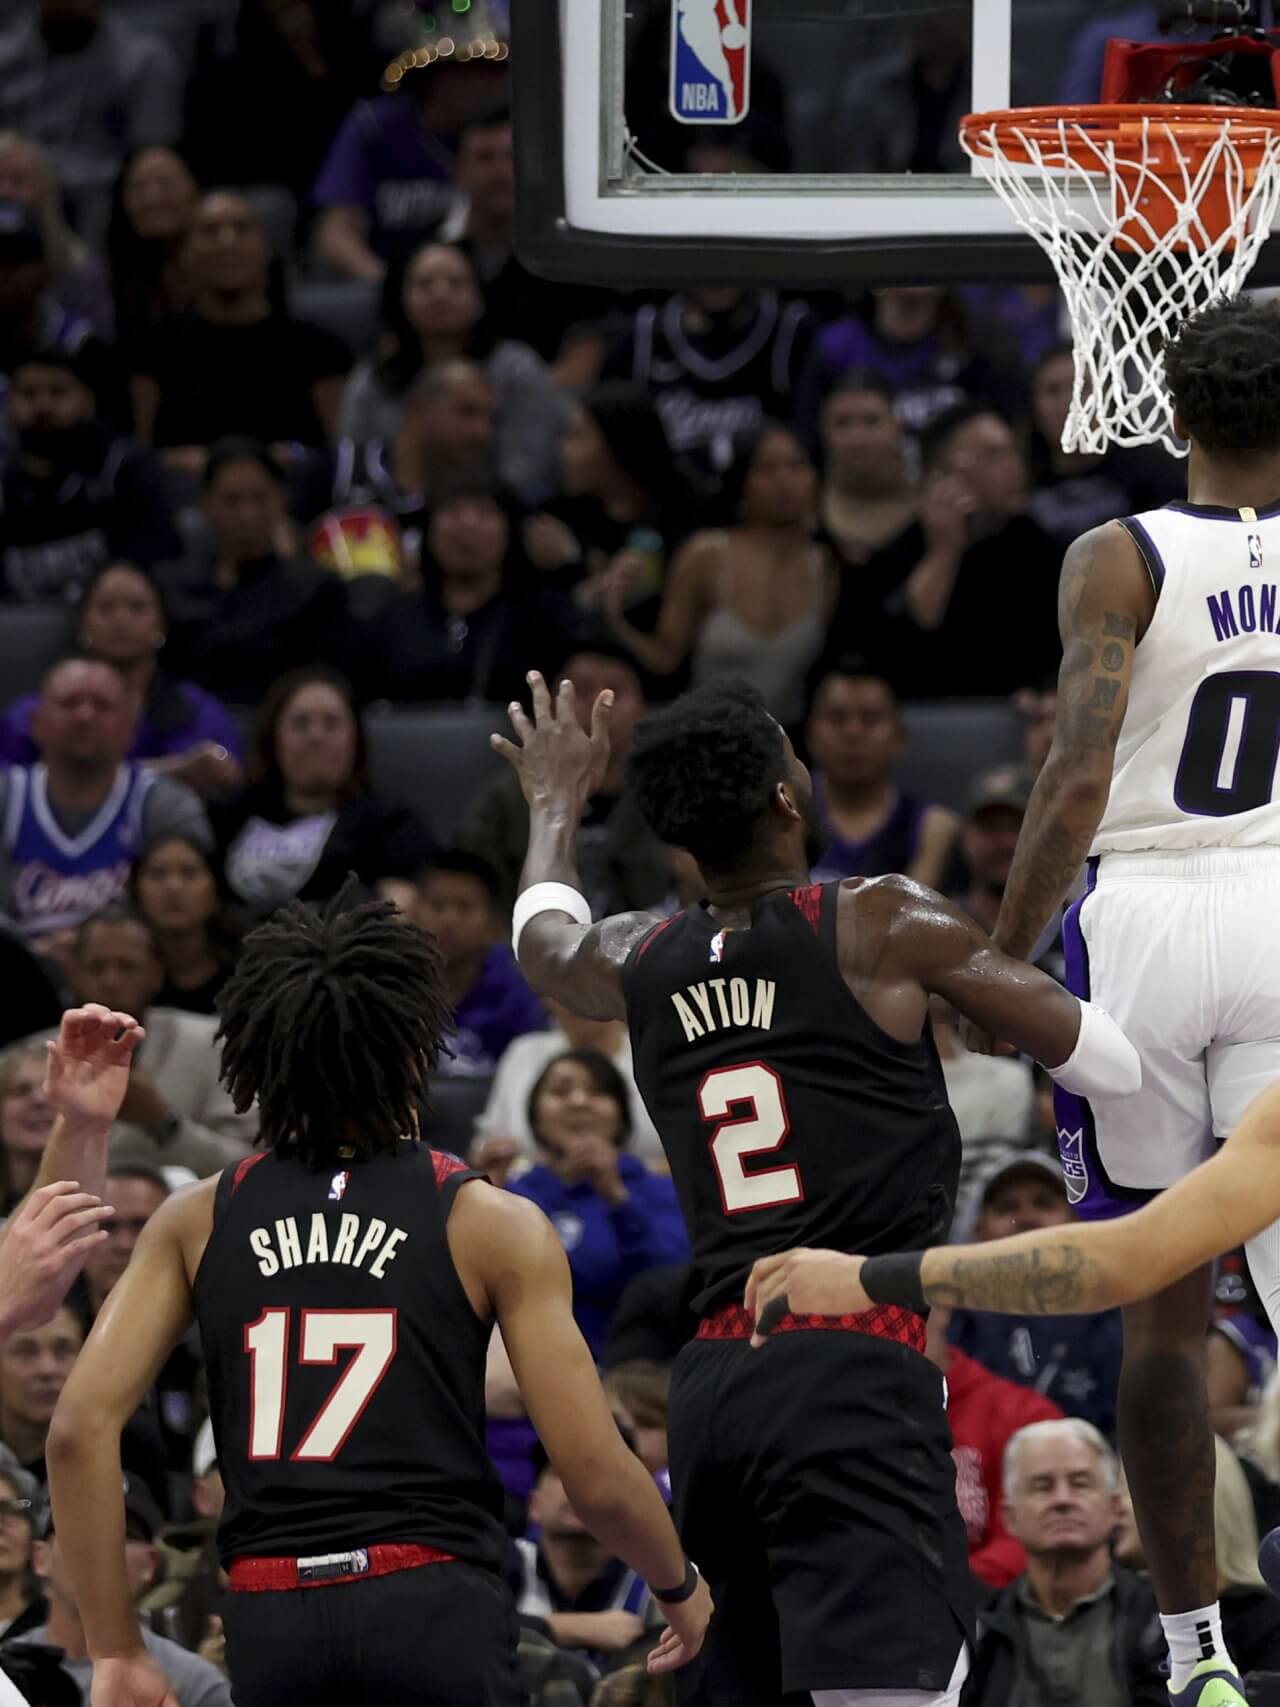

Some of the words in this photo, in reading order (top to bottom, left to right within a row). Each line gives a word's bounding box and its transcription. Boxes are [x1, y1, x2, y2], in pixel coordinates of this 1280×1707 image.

[682, 83, 719, 112] NBA
[670, 977, 777, 1042] AYTON
[696, 1060, 804, 1216] 2
[249, 1212, 409, 1280] SHARPE
[243, 1306, 398, 1462] 17
